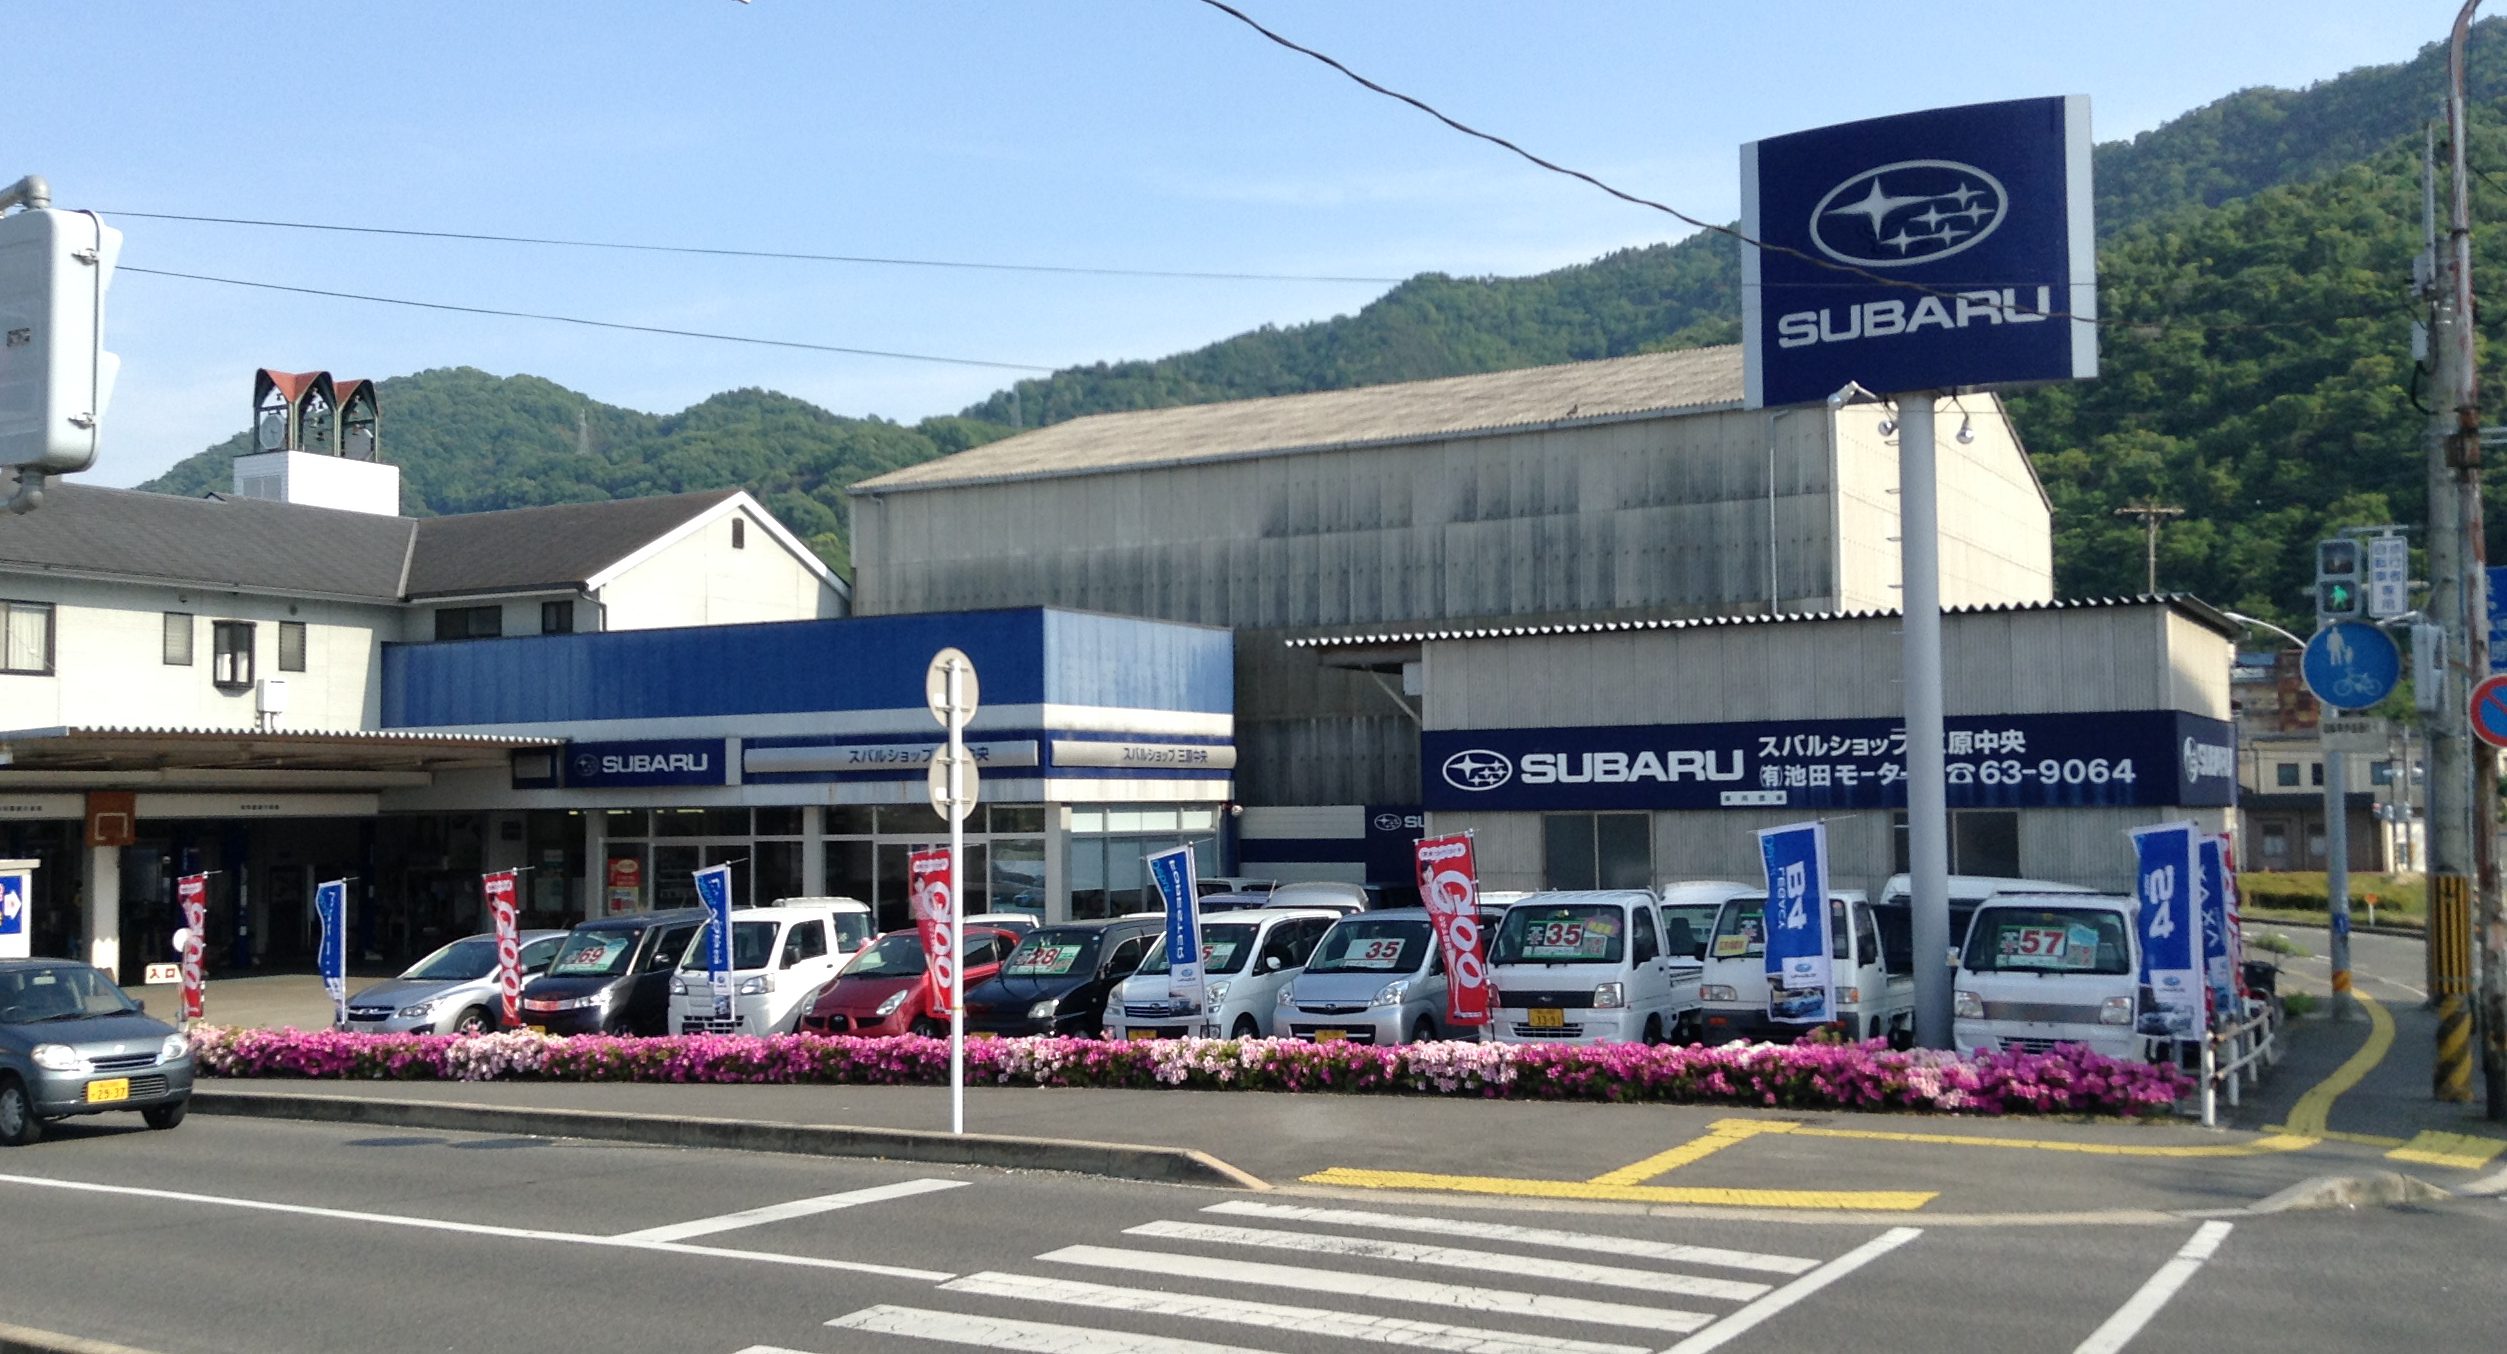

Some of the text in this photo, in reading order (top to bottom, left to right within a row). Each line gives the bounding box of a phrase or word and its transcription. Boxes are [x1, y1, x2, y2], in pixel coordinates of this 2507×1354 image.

[1778, 286, 2050, 348] SUBARU
[1943, 729, 2027, 755] 原中央
[602, 753, 708, 773] SUBARU
[1123, 747, 1176, 762] スバルショップ
[1520, 750, 1744, 783] SUBARU
[1979, 758, 2136, 784] 63-9064
[1546, 924, 1581, 945] 35
[2020, 930, 2063, 953] 57
[578, 946, 605, 963] 69
[1027, 946, 1058, 965] 28
[1202, 946, 1214, 960] 5
[1365, 941, 1400, 960] 35
[149, 968, 176, 979] 入口
